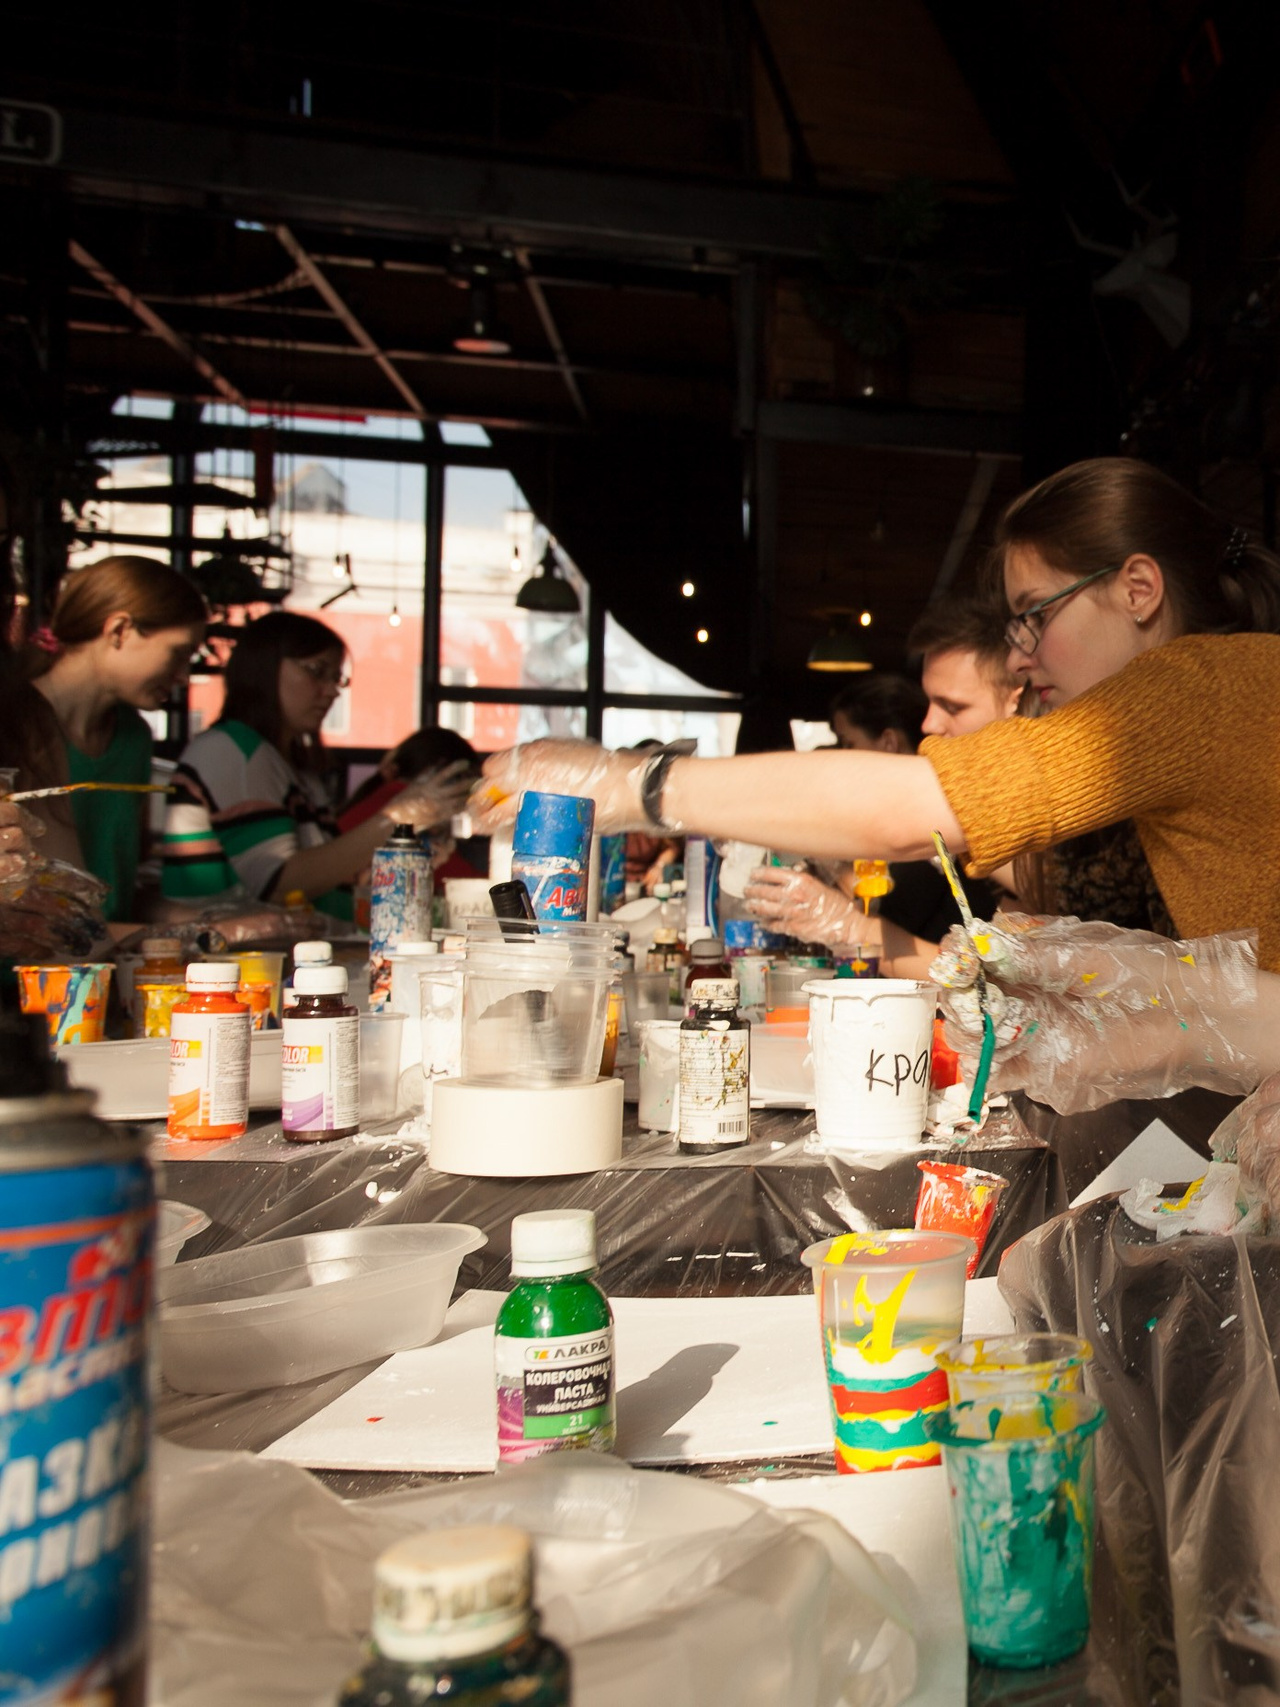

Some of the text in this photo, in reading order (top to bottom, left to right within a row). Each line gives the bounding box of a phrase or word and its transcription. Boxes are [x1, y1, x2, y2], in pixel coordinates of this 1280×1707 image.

[554, 1339, 607, 1359] ЛАКРА
[555, 1382, 595, 1401] ПАСТА
[569, 1414, 583, 1427] 21
